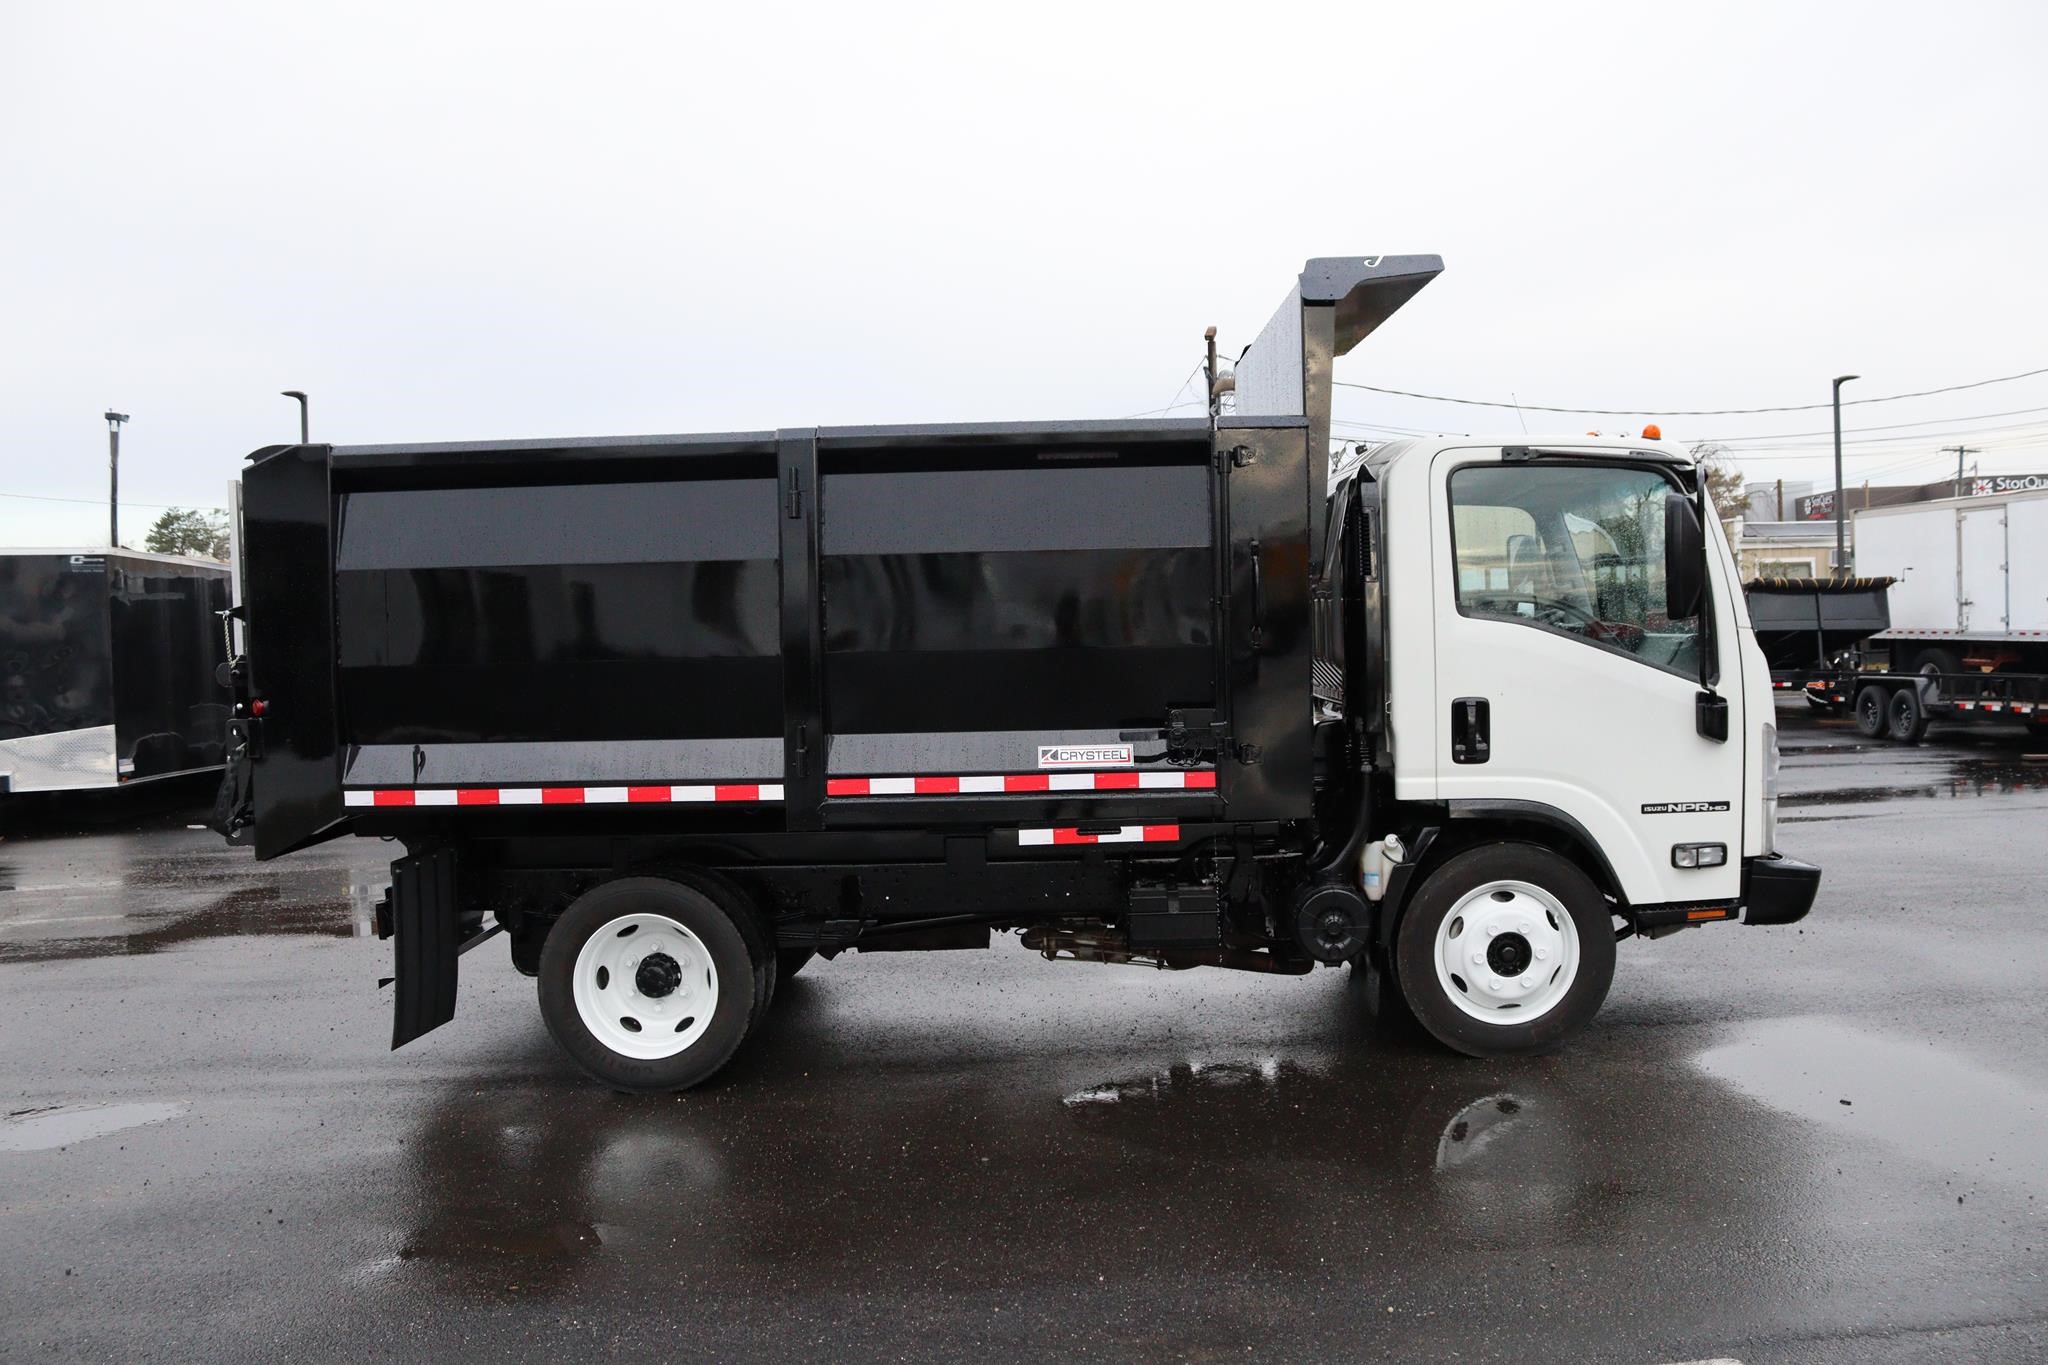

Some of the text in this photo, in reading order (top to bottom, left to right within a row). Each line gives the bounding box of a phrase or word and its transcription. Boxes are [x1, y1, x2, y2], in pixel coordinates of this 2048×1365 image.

[1996, 476, 2048, 490] StorQu
[1060, 750, 1127, 761] CRYSTEEL
[1668, 803, 1709, 812] NPR
